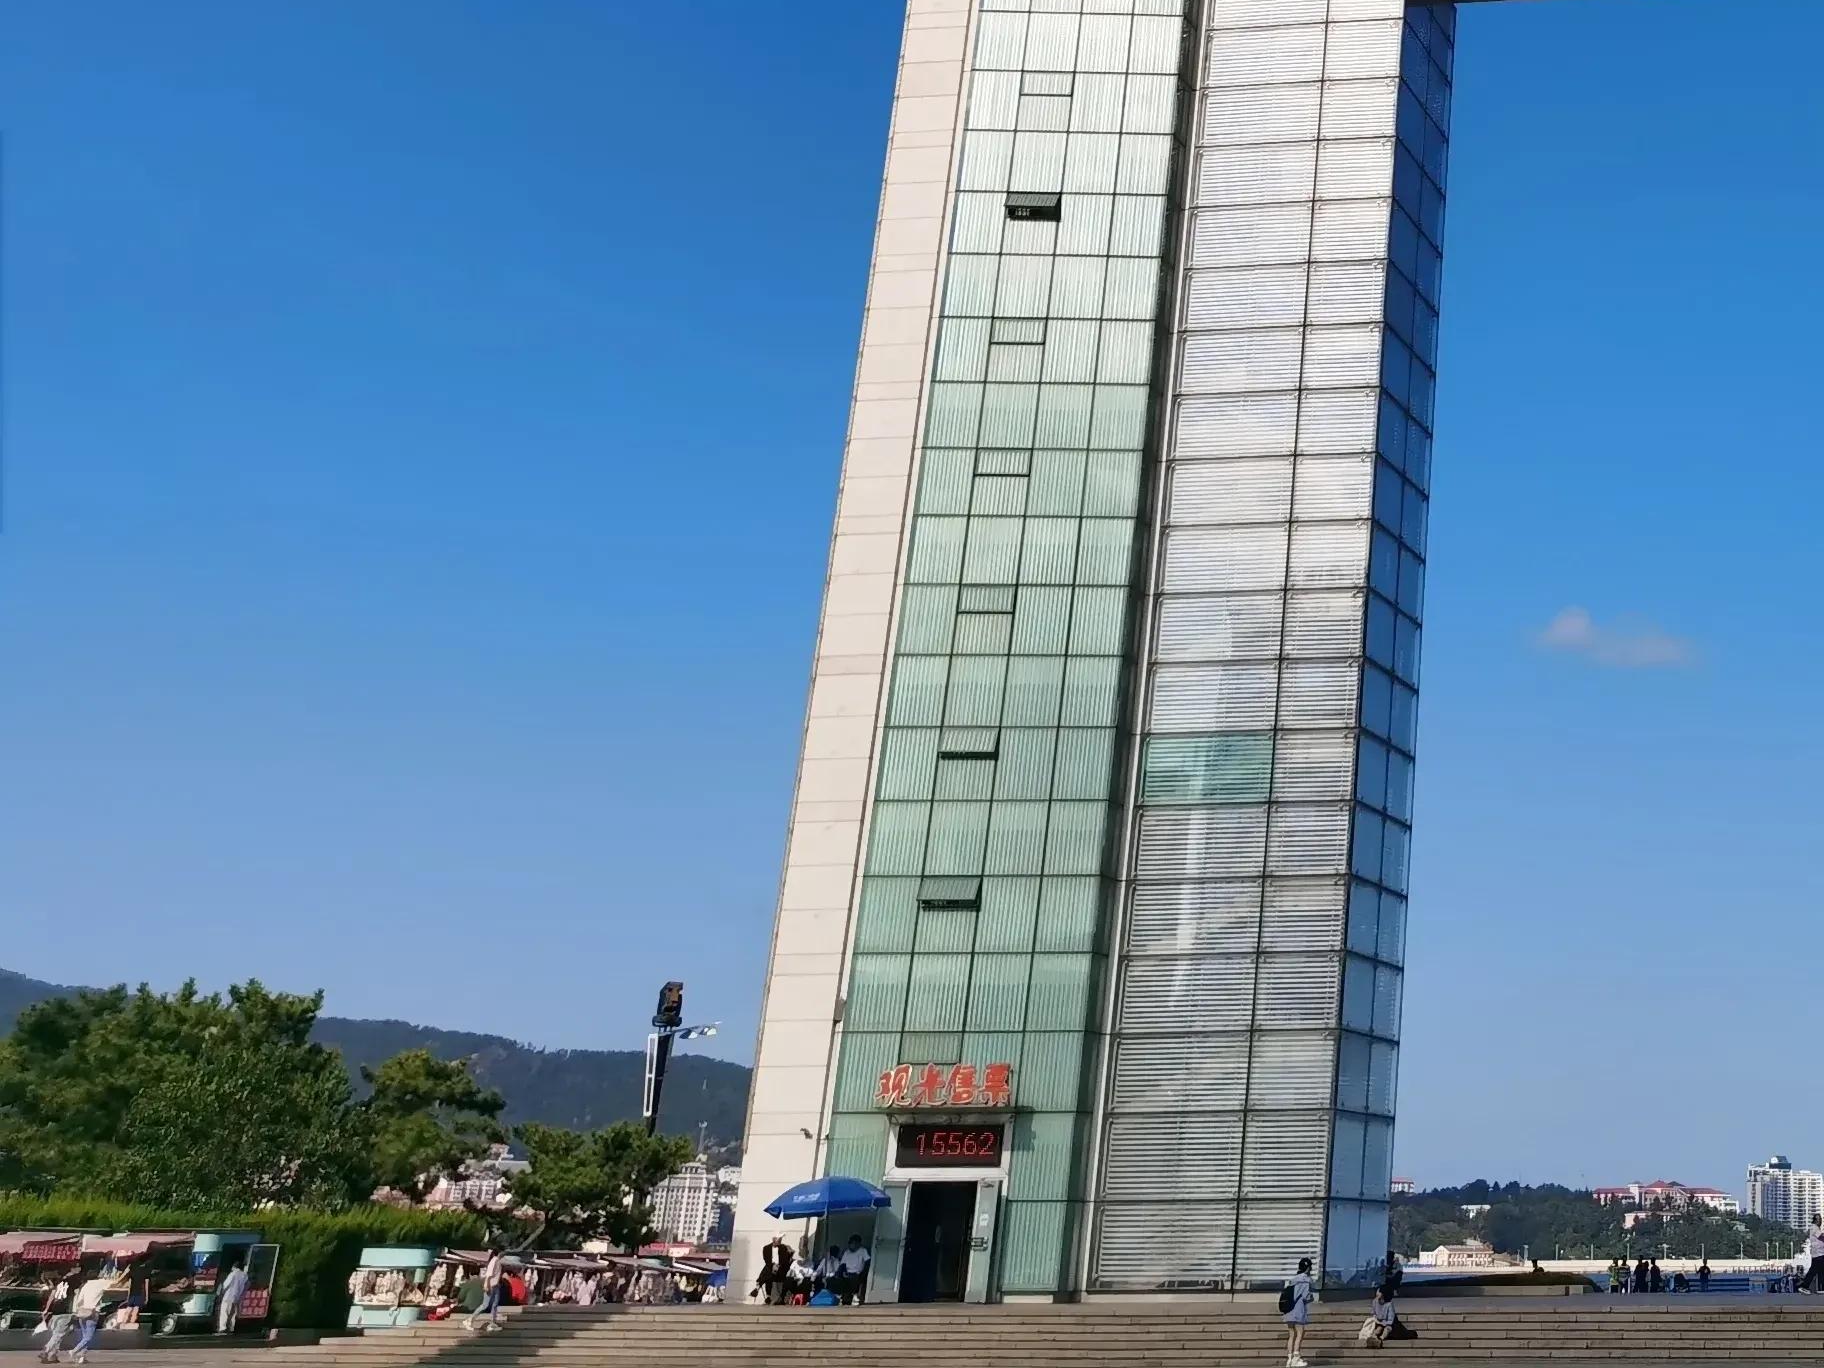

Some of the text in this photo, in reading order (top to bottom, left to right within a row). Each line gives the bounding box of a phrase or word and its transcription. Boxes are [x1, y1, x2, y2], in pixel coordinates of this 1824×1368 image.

[874, 1063, 1012, 1107] 观光售票
[916, 1132, 995, 1156] 15562
